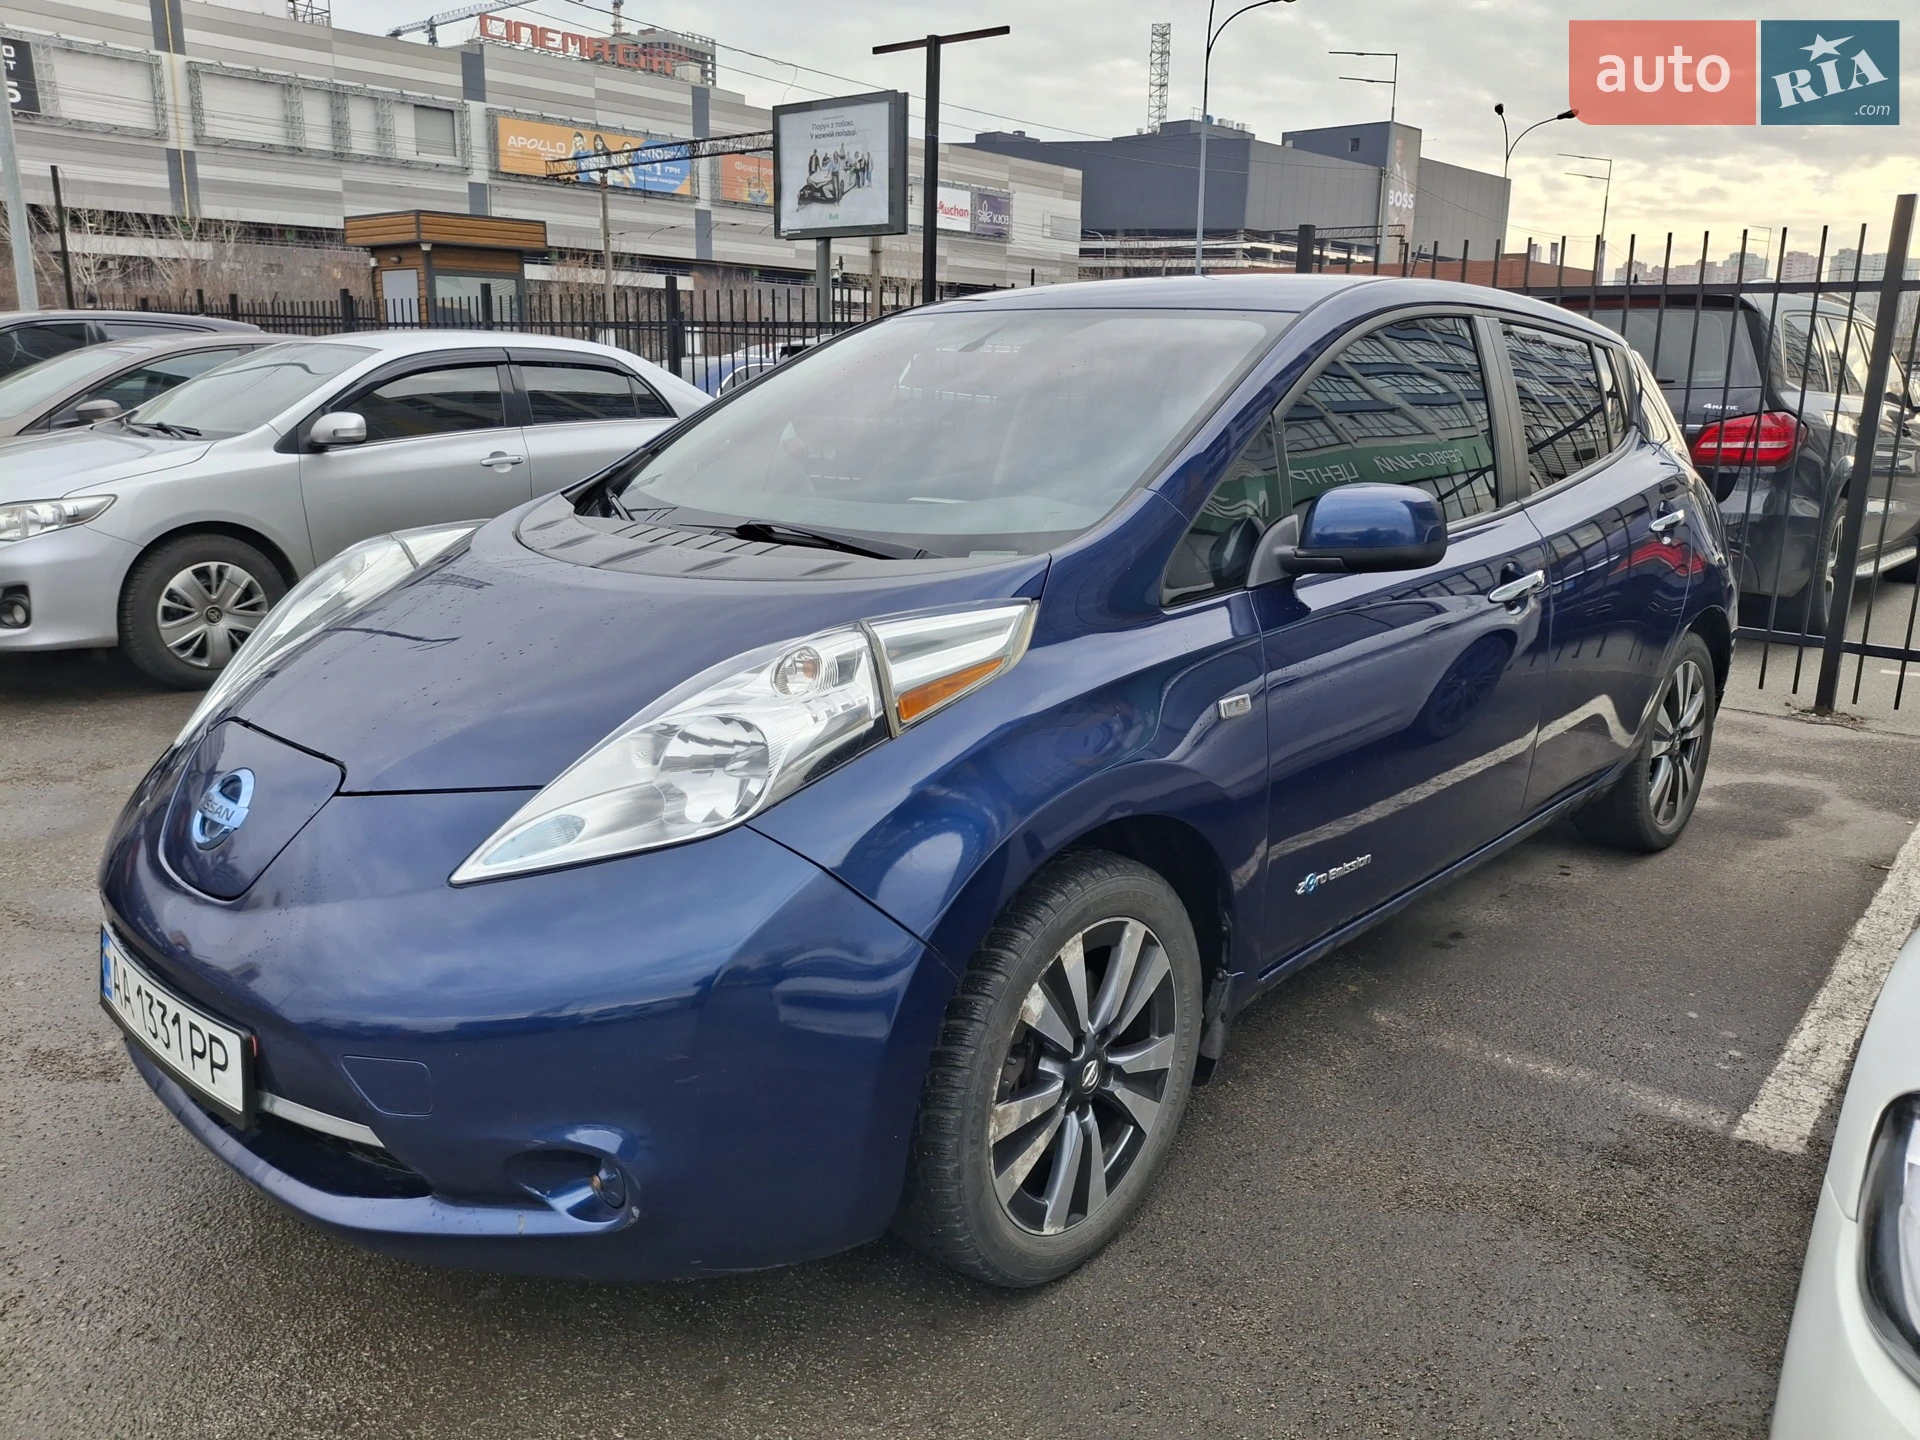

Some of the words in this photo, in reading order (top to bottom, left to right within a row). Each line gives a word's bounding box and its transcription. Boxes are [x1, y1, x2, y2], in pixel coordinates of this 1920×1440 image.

[479, 14, 611, 63] CINEMA
[508, 135, 566, 153] APOLLO
[938, 201, 970, 218] Auchan
[1388, 190, 1414, 209] BOSS
[1328, 854, 1372, 881] Emission
[136, 984, 184, 1062] 1331
